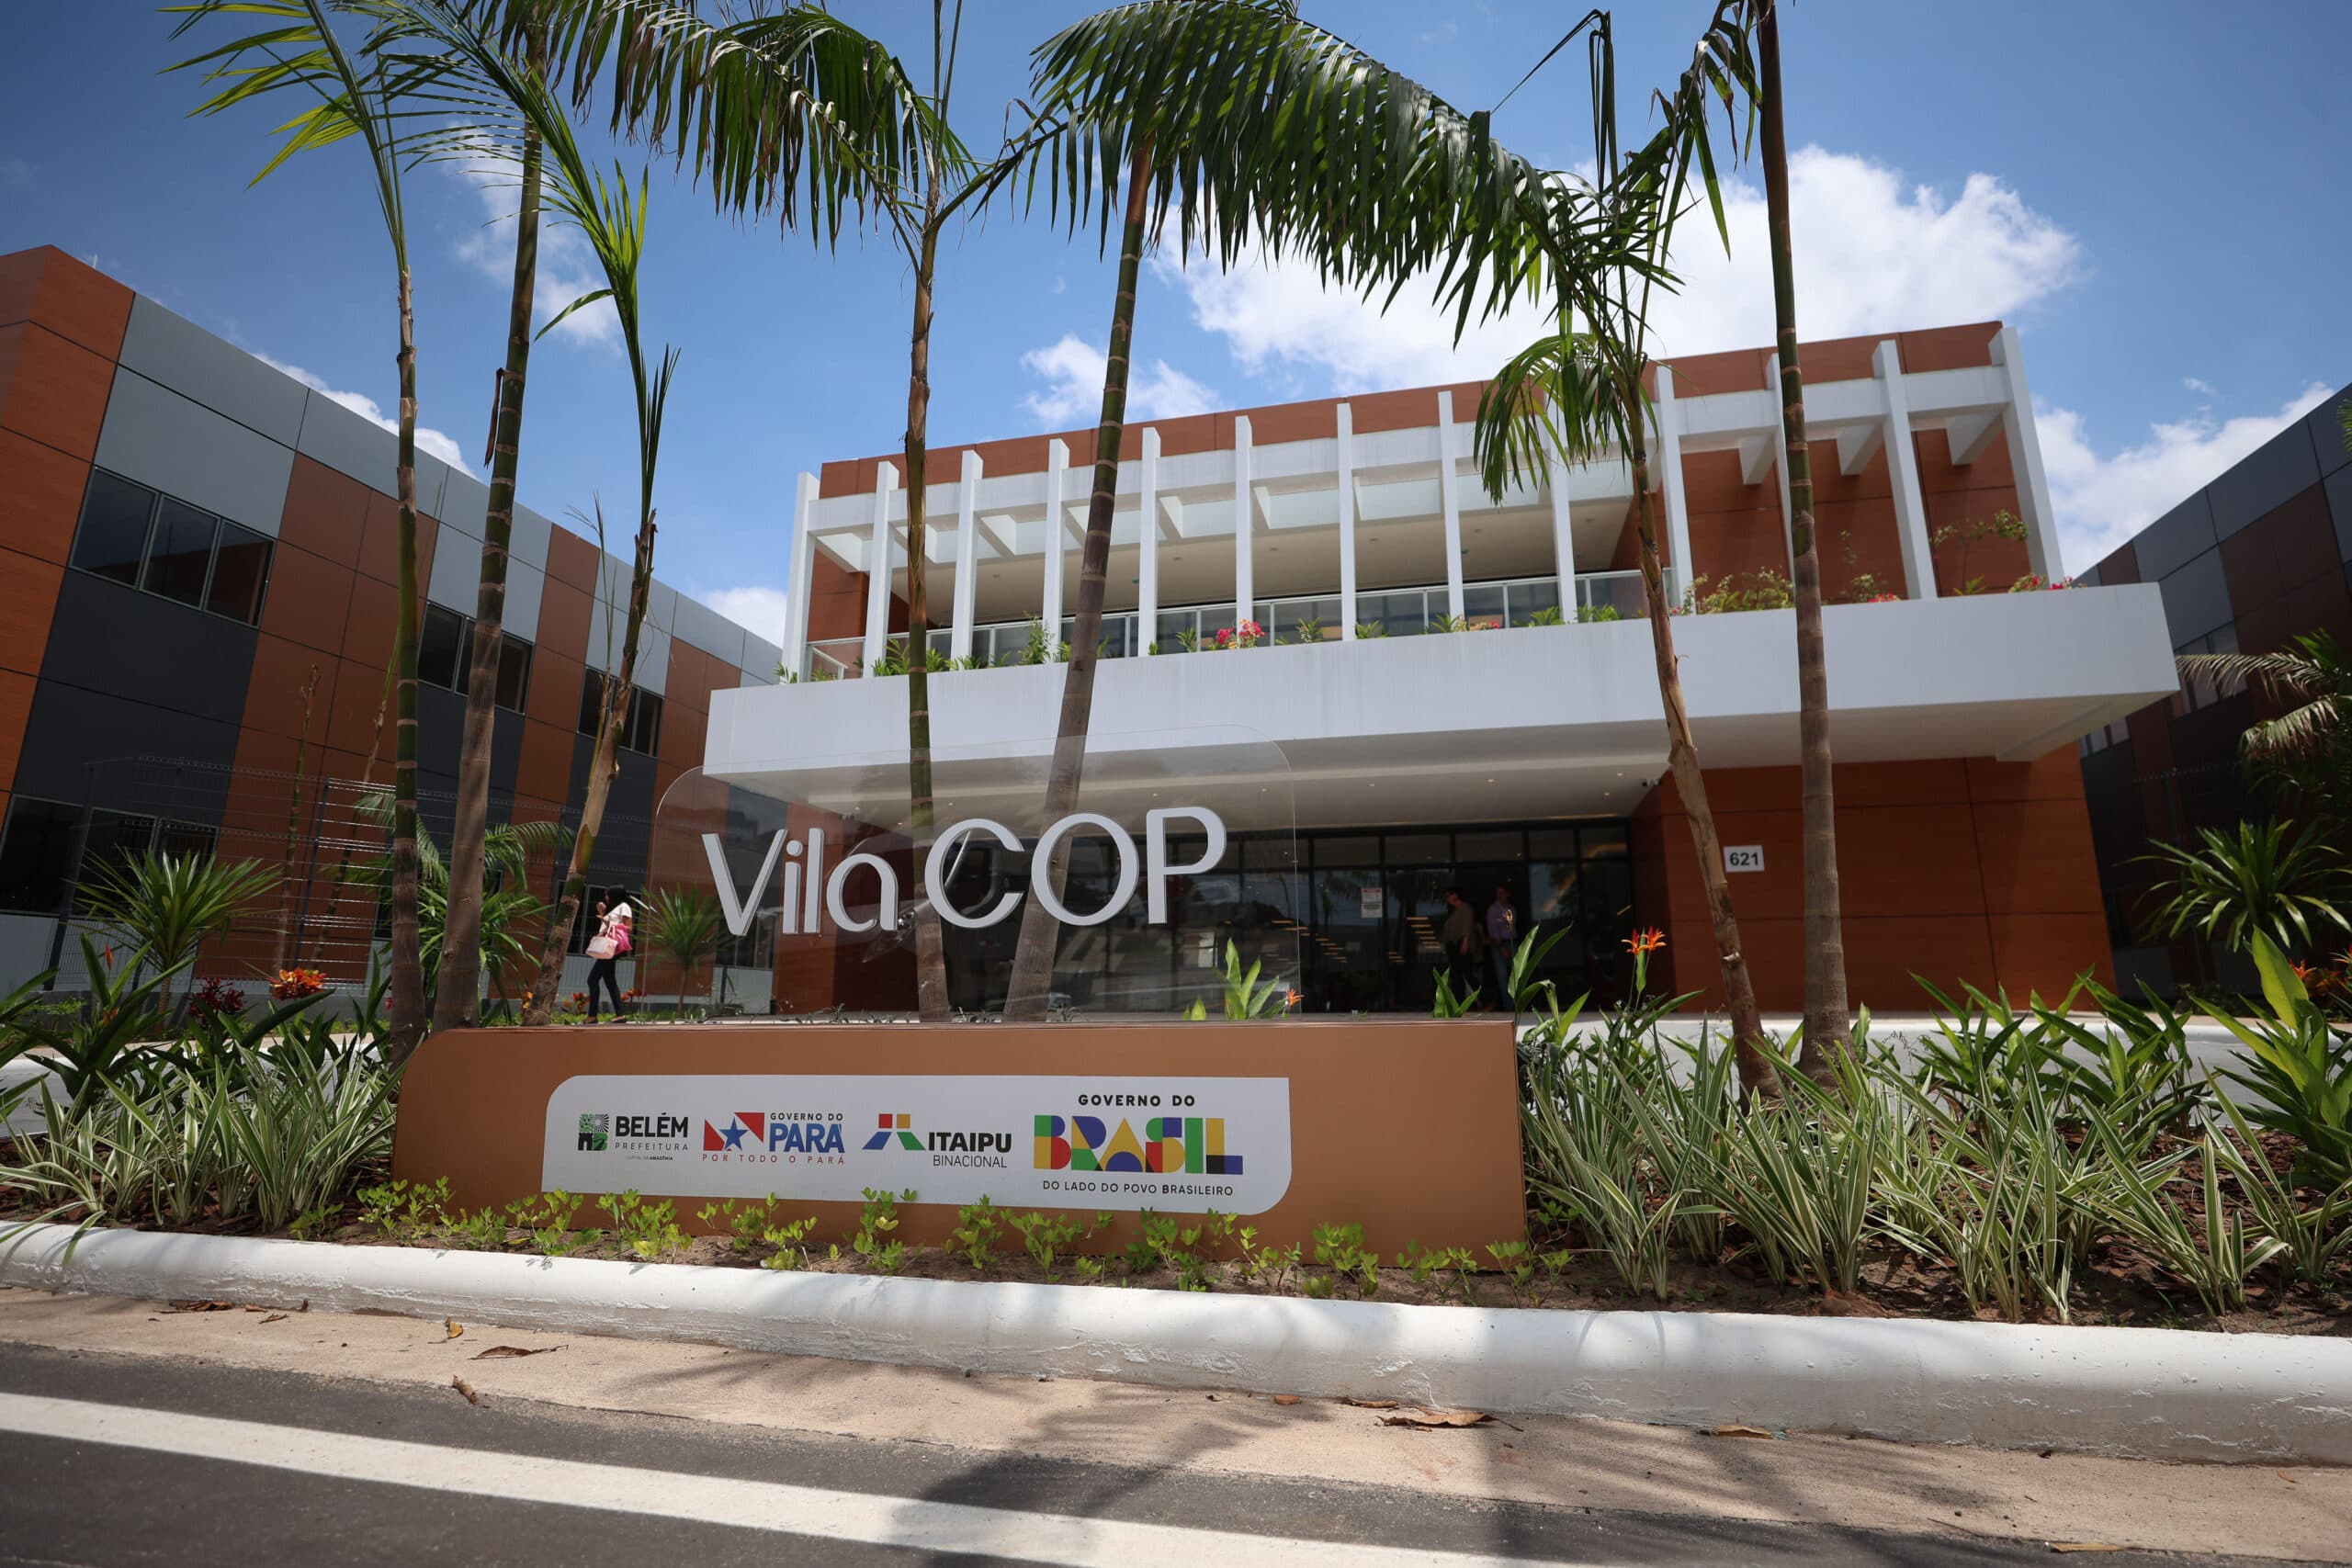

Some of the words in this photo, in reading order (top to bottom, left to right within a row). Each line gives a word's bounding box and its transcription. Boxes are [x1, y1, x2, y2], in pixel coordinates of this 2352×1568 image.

[1729, 852, 1758, 866] 621
[701, 828, 899, 936] Vila
[924, 807, 1227, 928] COP
[1078, 1094, 1161, 1107] GOVERNO
[1171, 1095, 1195, 1107] DO
[770, 1112, 823, 1121] GOVERNO
[615, 1111, 689, 1138] BELÉM
[768, 1122, 846, 1154] PARÁ
[928, 1132, 1012, 1154] ITAIPU
[1034, 1114, 1243, 1176] BRASIL
[615, 1142, 689, 1151] PREFEITURA
[702, 1154, 729, 1162] POR
[739, 1155, 778, 1163] TODO
[788, 1155, 797, 1164] O
[807, 1155, 845, 1165] PARÁ
[933, 1155, 1008, 1168] BINACIONAL
[1043, 1180, 1060, 1190] DO
[1064, 1181, 1097, 1192] LADO
[1101, 1182, 1119, 1193] DO
[1124, 1183, 1158, 1194] POVO
[1161, 1184, 1234, 1196] BRASILEIRO
